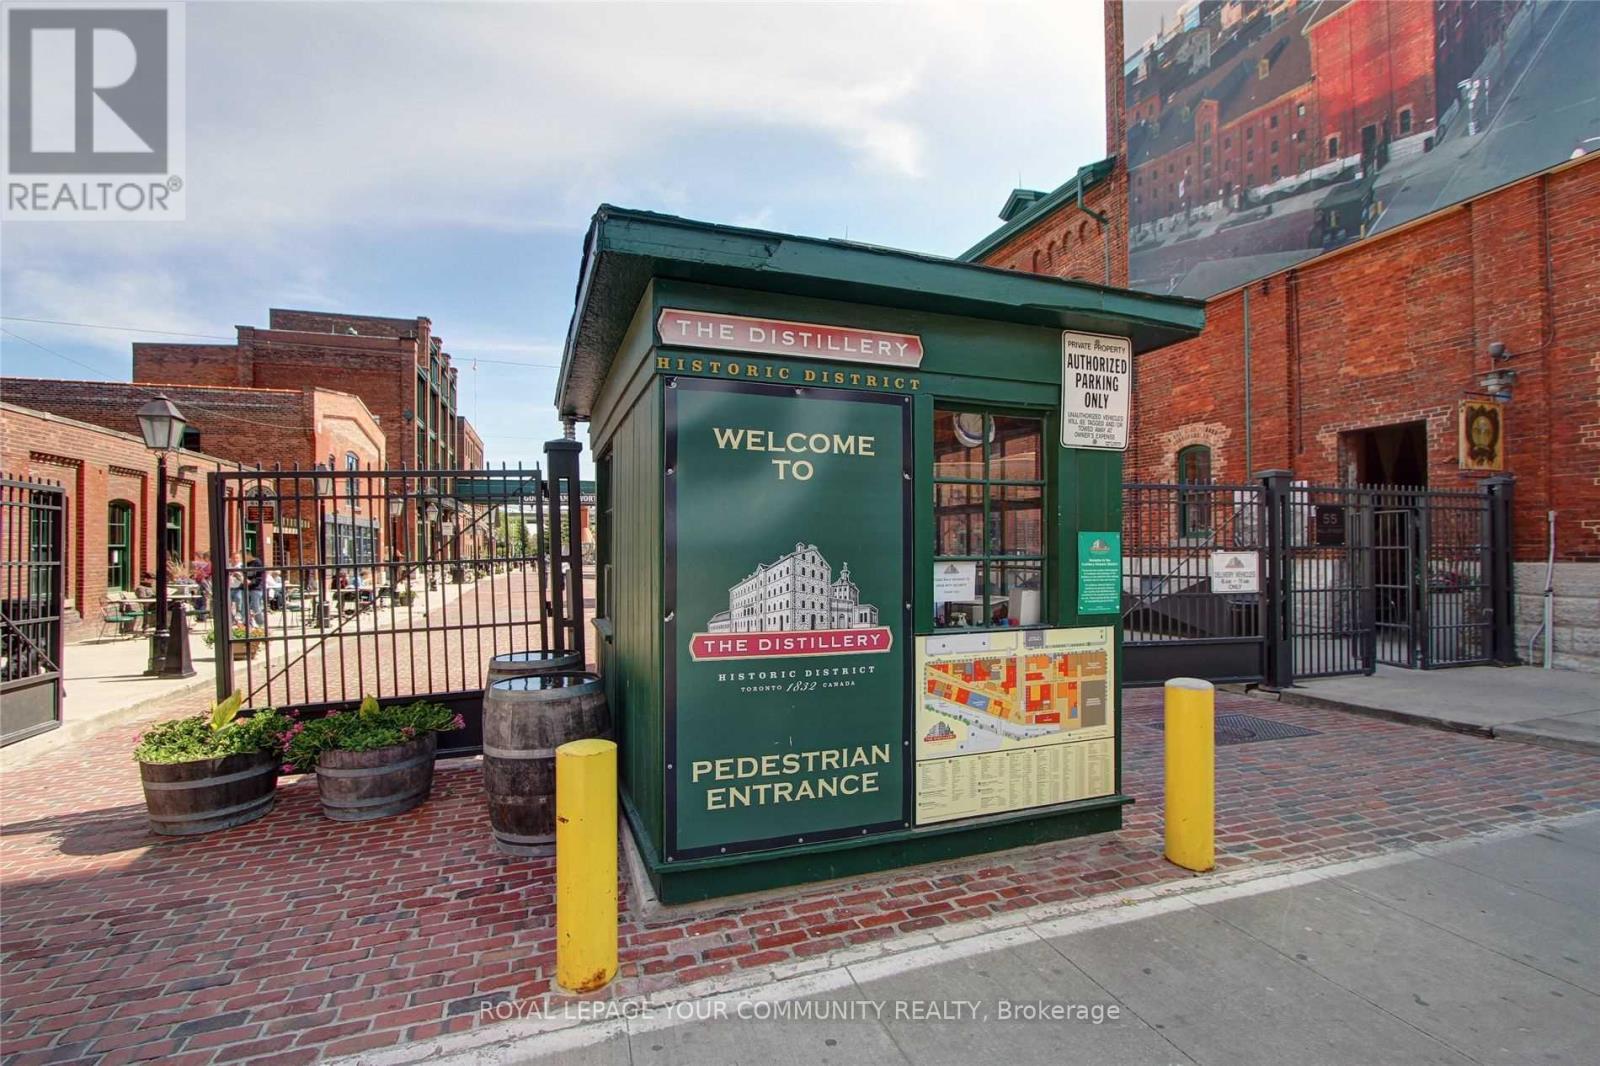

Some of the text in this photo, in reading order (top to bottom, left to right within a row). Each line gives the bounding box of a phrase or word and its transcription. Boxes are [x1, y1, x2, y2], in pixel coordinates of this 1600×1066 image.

[676, 319, 909, 358] THE DISTILLERY
[1067, 340, 1126, 354] PRIVATE PROPERTY
[656, 356, 920, 390] HISTORIC DISTRICT
[1067, 353, 1127, 375] AUTHORIZED
[1075, 372, 1119, 392] PARKING
[1084, 391, 1109, 409] ONLY
[713, 428, 875, 456] WELCOME
[772, 458, 814, 481] TO
[704, 633, 881, 653] THE DISTILLERY
[718, 665, 876, 682] HISTORIC DISTRICT
[740, 680, 856, 693] TORONTO 1832 CANADA
[692, 743, 891, 783] PEDESTRIAN
[706, 772, 880, 810] ENTRANCE
